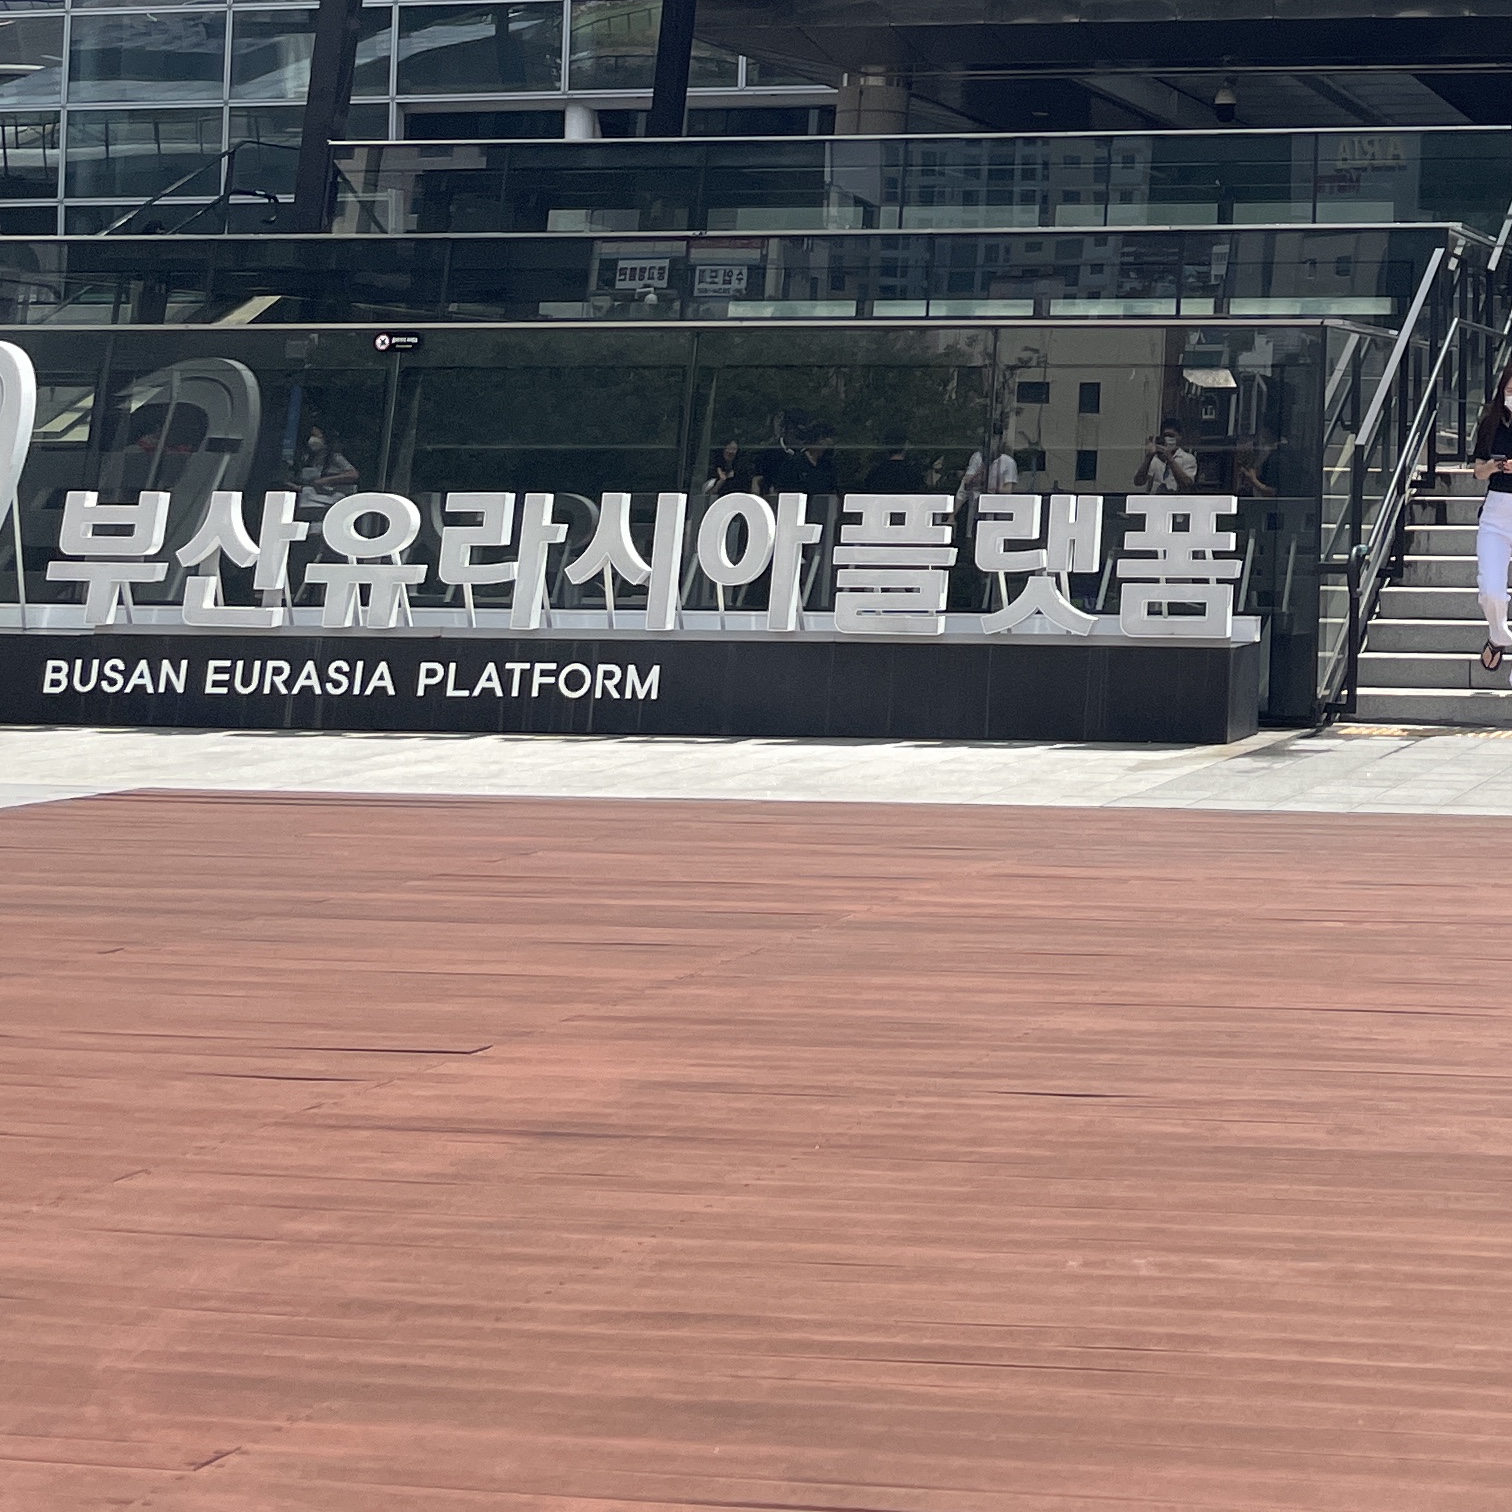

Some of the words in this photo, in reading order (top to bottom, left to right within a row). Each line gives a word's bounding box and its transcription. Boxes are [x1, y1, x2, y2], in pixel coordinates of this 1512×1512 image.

[45, 490, 1243, 639] 부산유라시아플랫폼
[42, 658, 189, 694] BUSAN
[205, 659, 396, 697] EURASIA
[417, 661, 662, 700] PLATFORM
